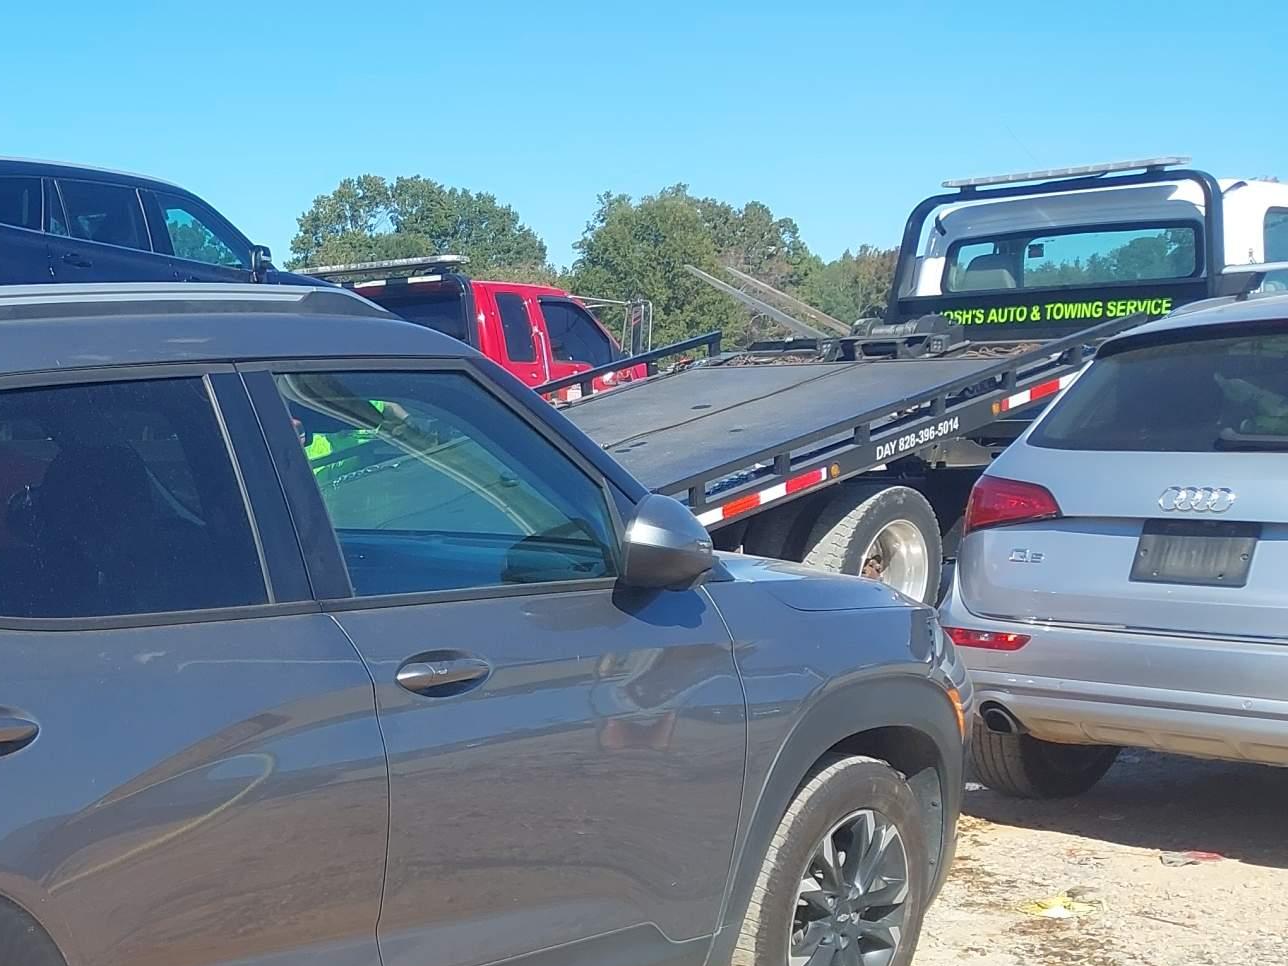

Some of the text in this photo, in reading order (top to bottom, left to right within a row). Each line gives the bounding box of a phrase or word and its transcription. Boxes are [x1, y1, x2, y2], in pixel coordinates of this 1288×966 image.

[941, 298, 1172, 325] OSH'S AUTO & TOWING SERVICE
[876, 416, 959, 461] DAY 828-396-5014
